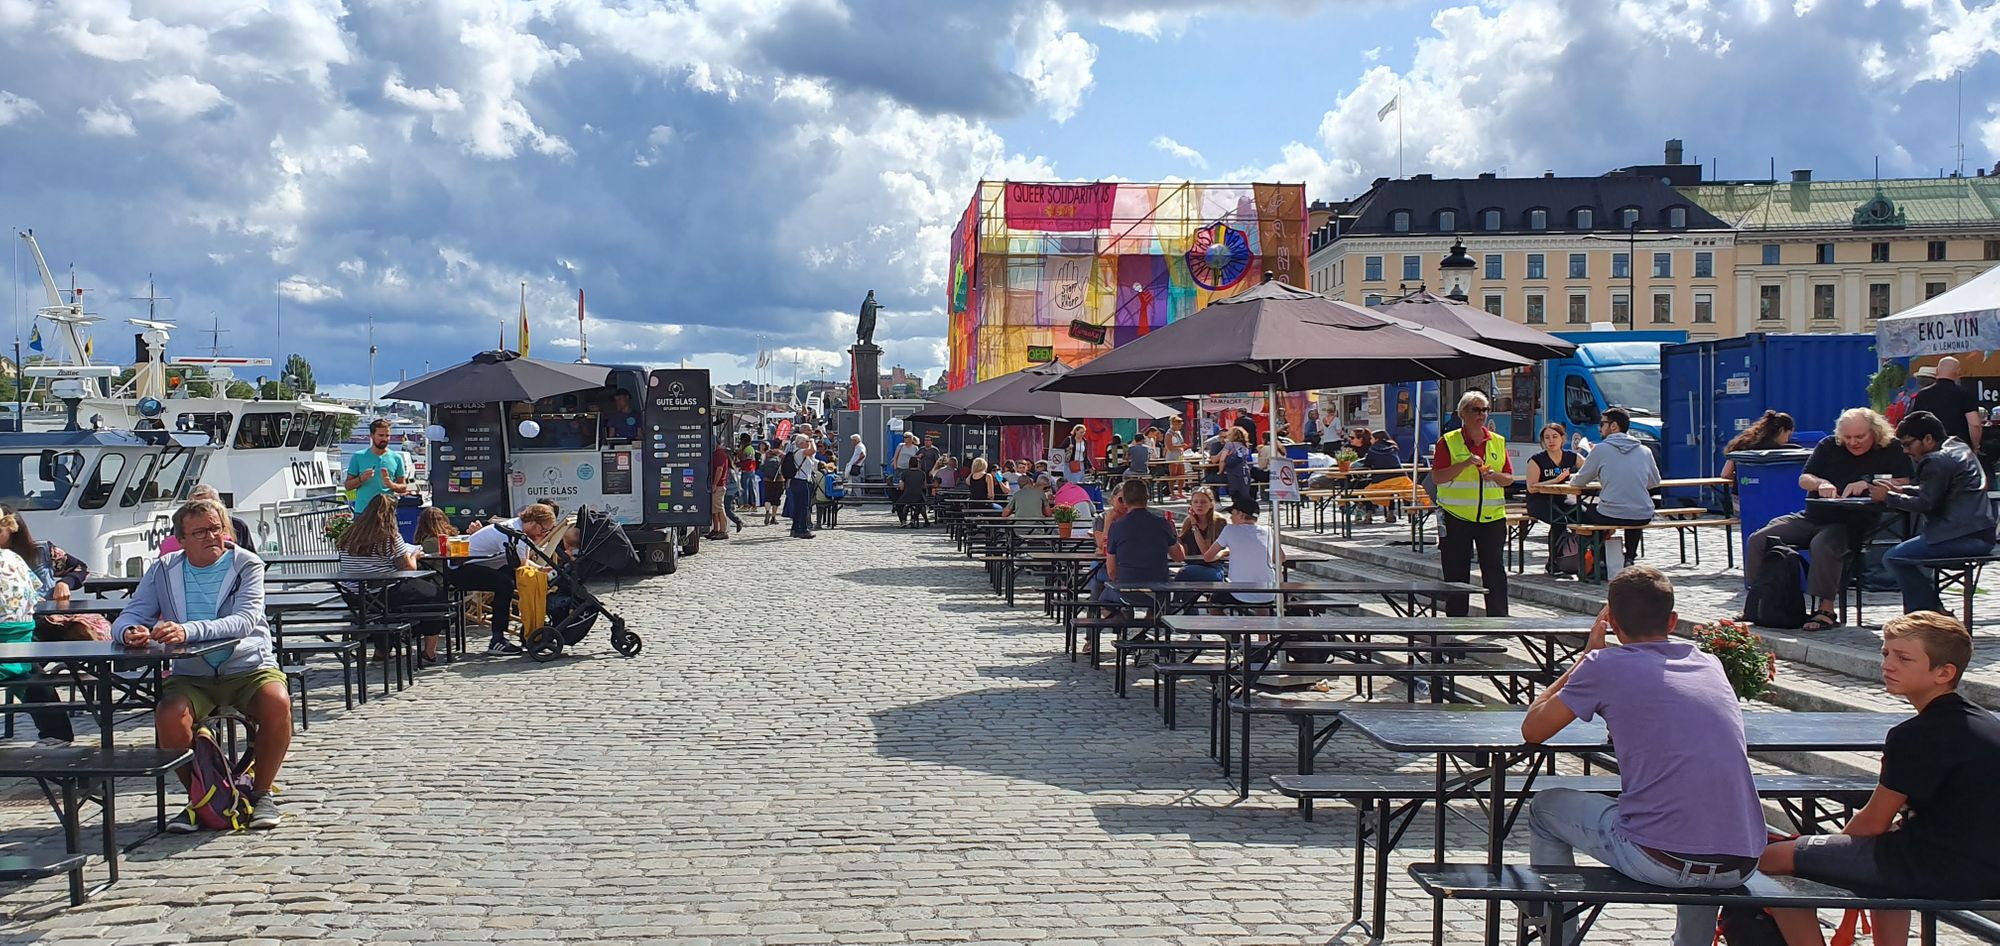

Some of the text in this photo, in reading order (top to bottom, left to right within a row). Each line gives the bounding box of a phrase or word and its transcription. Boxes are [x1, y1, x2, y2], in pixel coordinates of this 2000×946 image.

[1013, 185, 1111, 204] QUEER SOLIDARITY IS
[1918, 318, 1979, 341] EKO-VIN
[1940, 340, 1970, 351] LEMONAD
[1028, 349, 1052, 360] OPEN
[656, 398, 697, 406] GUTE GLASS
[289, 457, 327, 486] ÖSTAN
[527, 486, 578, 496] GUTE GLASS
